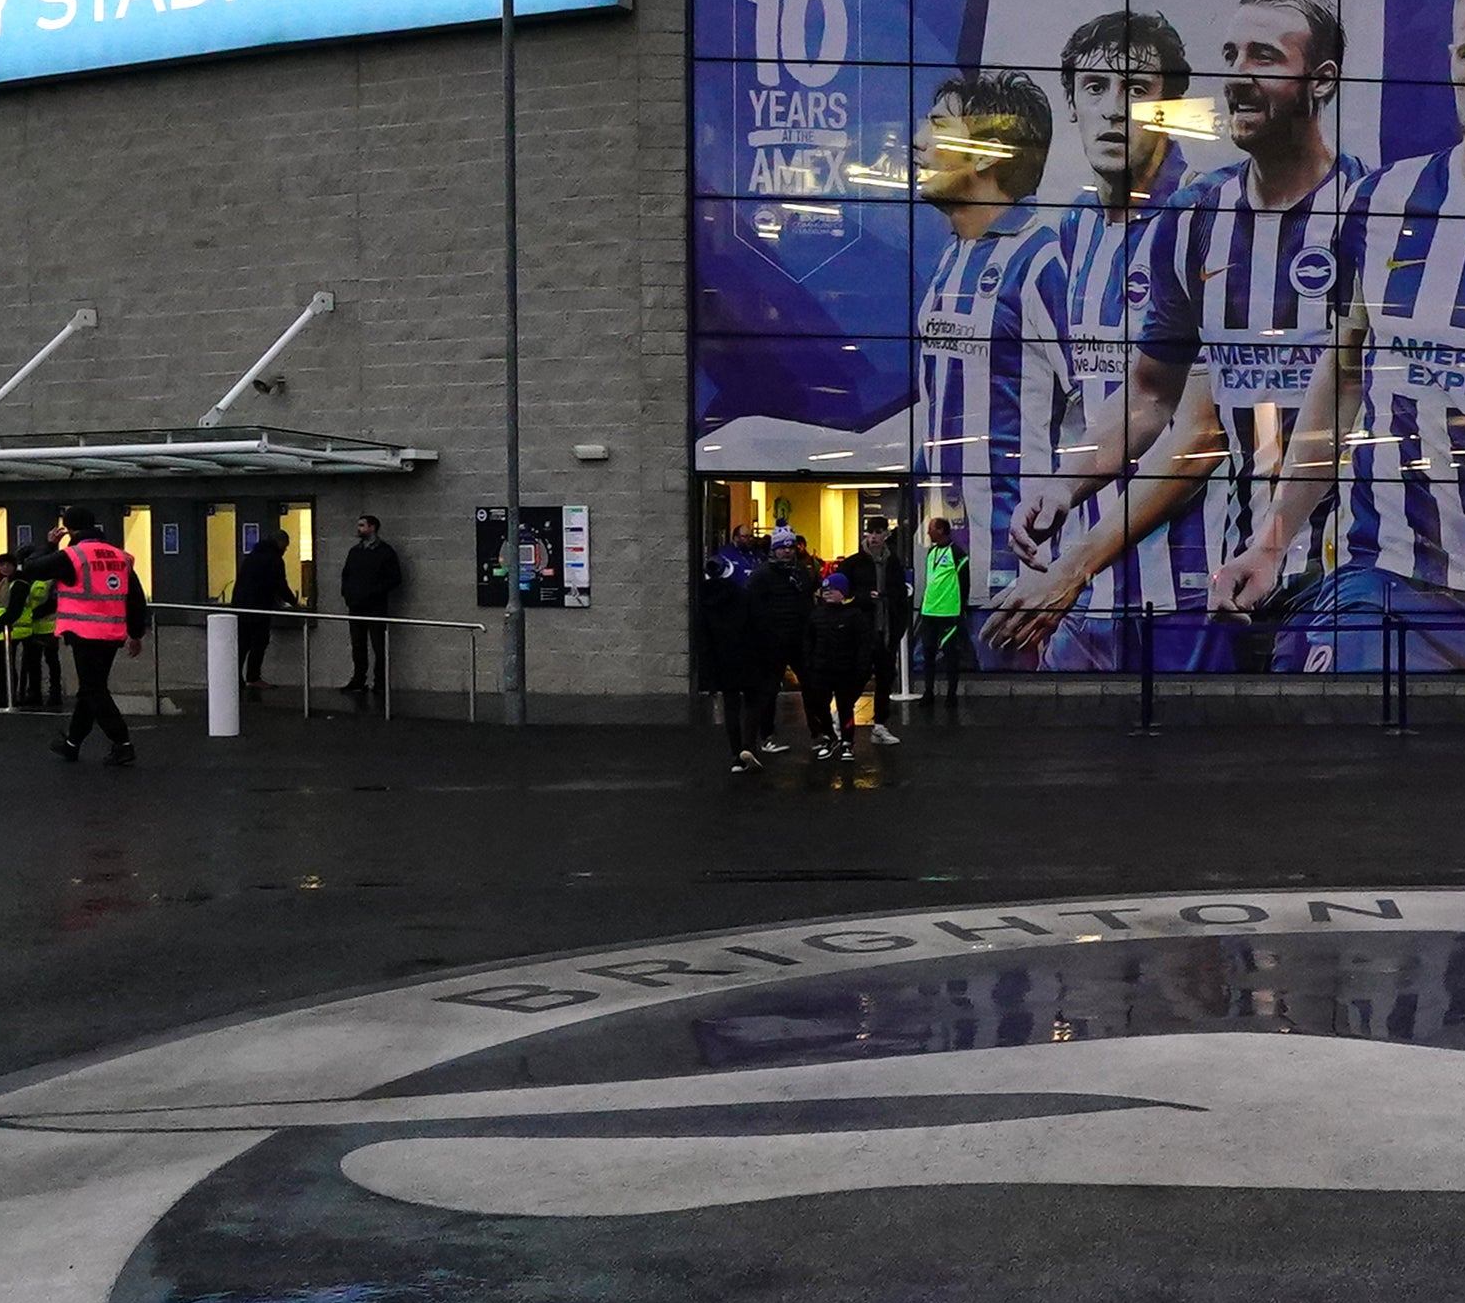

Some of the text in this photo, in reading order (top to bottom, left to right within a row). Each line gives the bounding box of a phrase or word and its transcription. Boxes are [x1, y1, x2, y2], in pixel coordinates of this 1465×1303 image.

[748, 89, 848, 130] YEARS
[781, 129, 815, 143] AT THE
[748, 147, 847, 195] AMEX
[1220, 368, 1314, 389] EXPRES
[433, 896, 1405, 1013] BRIGHTON
